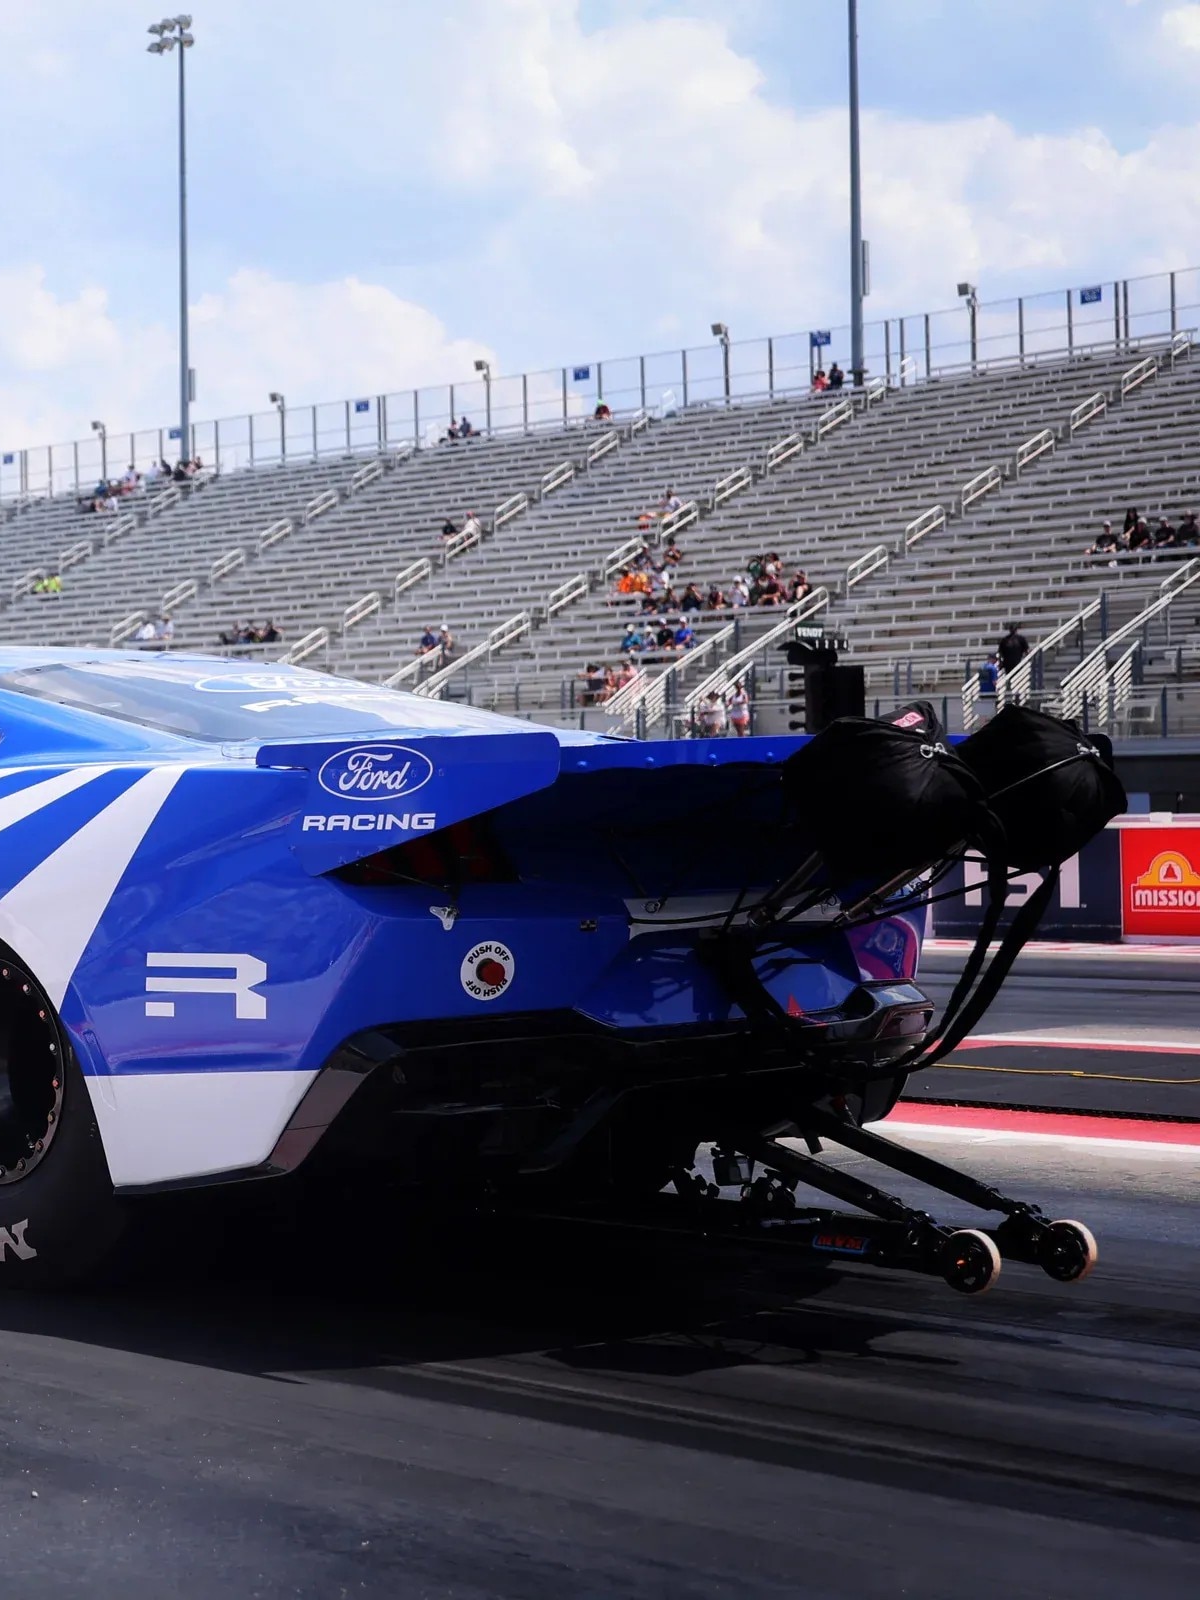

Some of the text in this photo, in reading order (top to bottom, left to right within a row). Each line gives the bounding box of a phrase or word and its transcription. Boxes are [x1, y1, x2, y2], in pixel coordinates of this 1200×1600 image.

[338, 752, 412, 791] Ford
[302, 812, 437, 832] RACING
[467, 944, 510, 965] PUSH OFF
[465, 977, 508, 997] PUSH OFF
